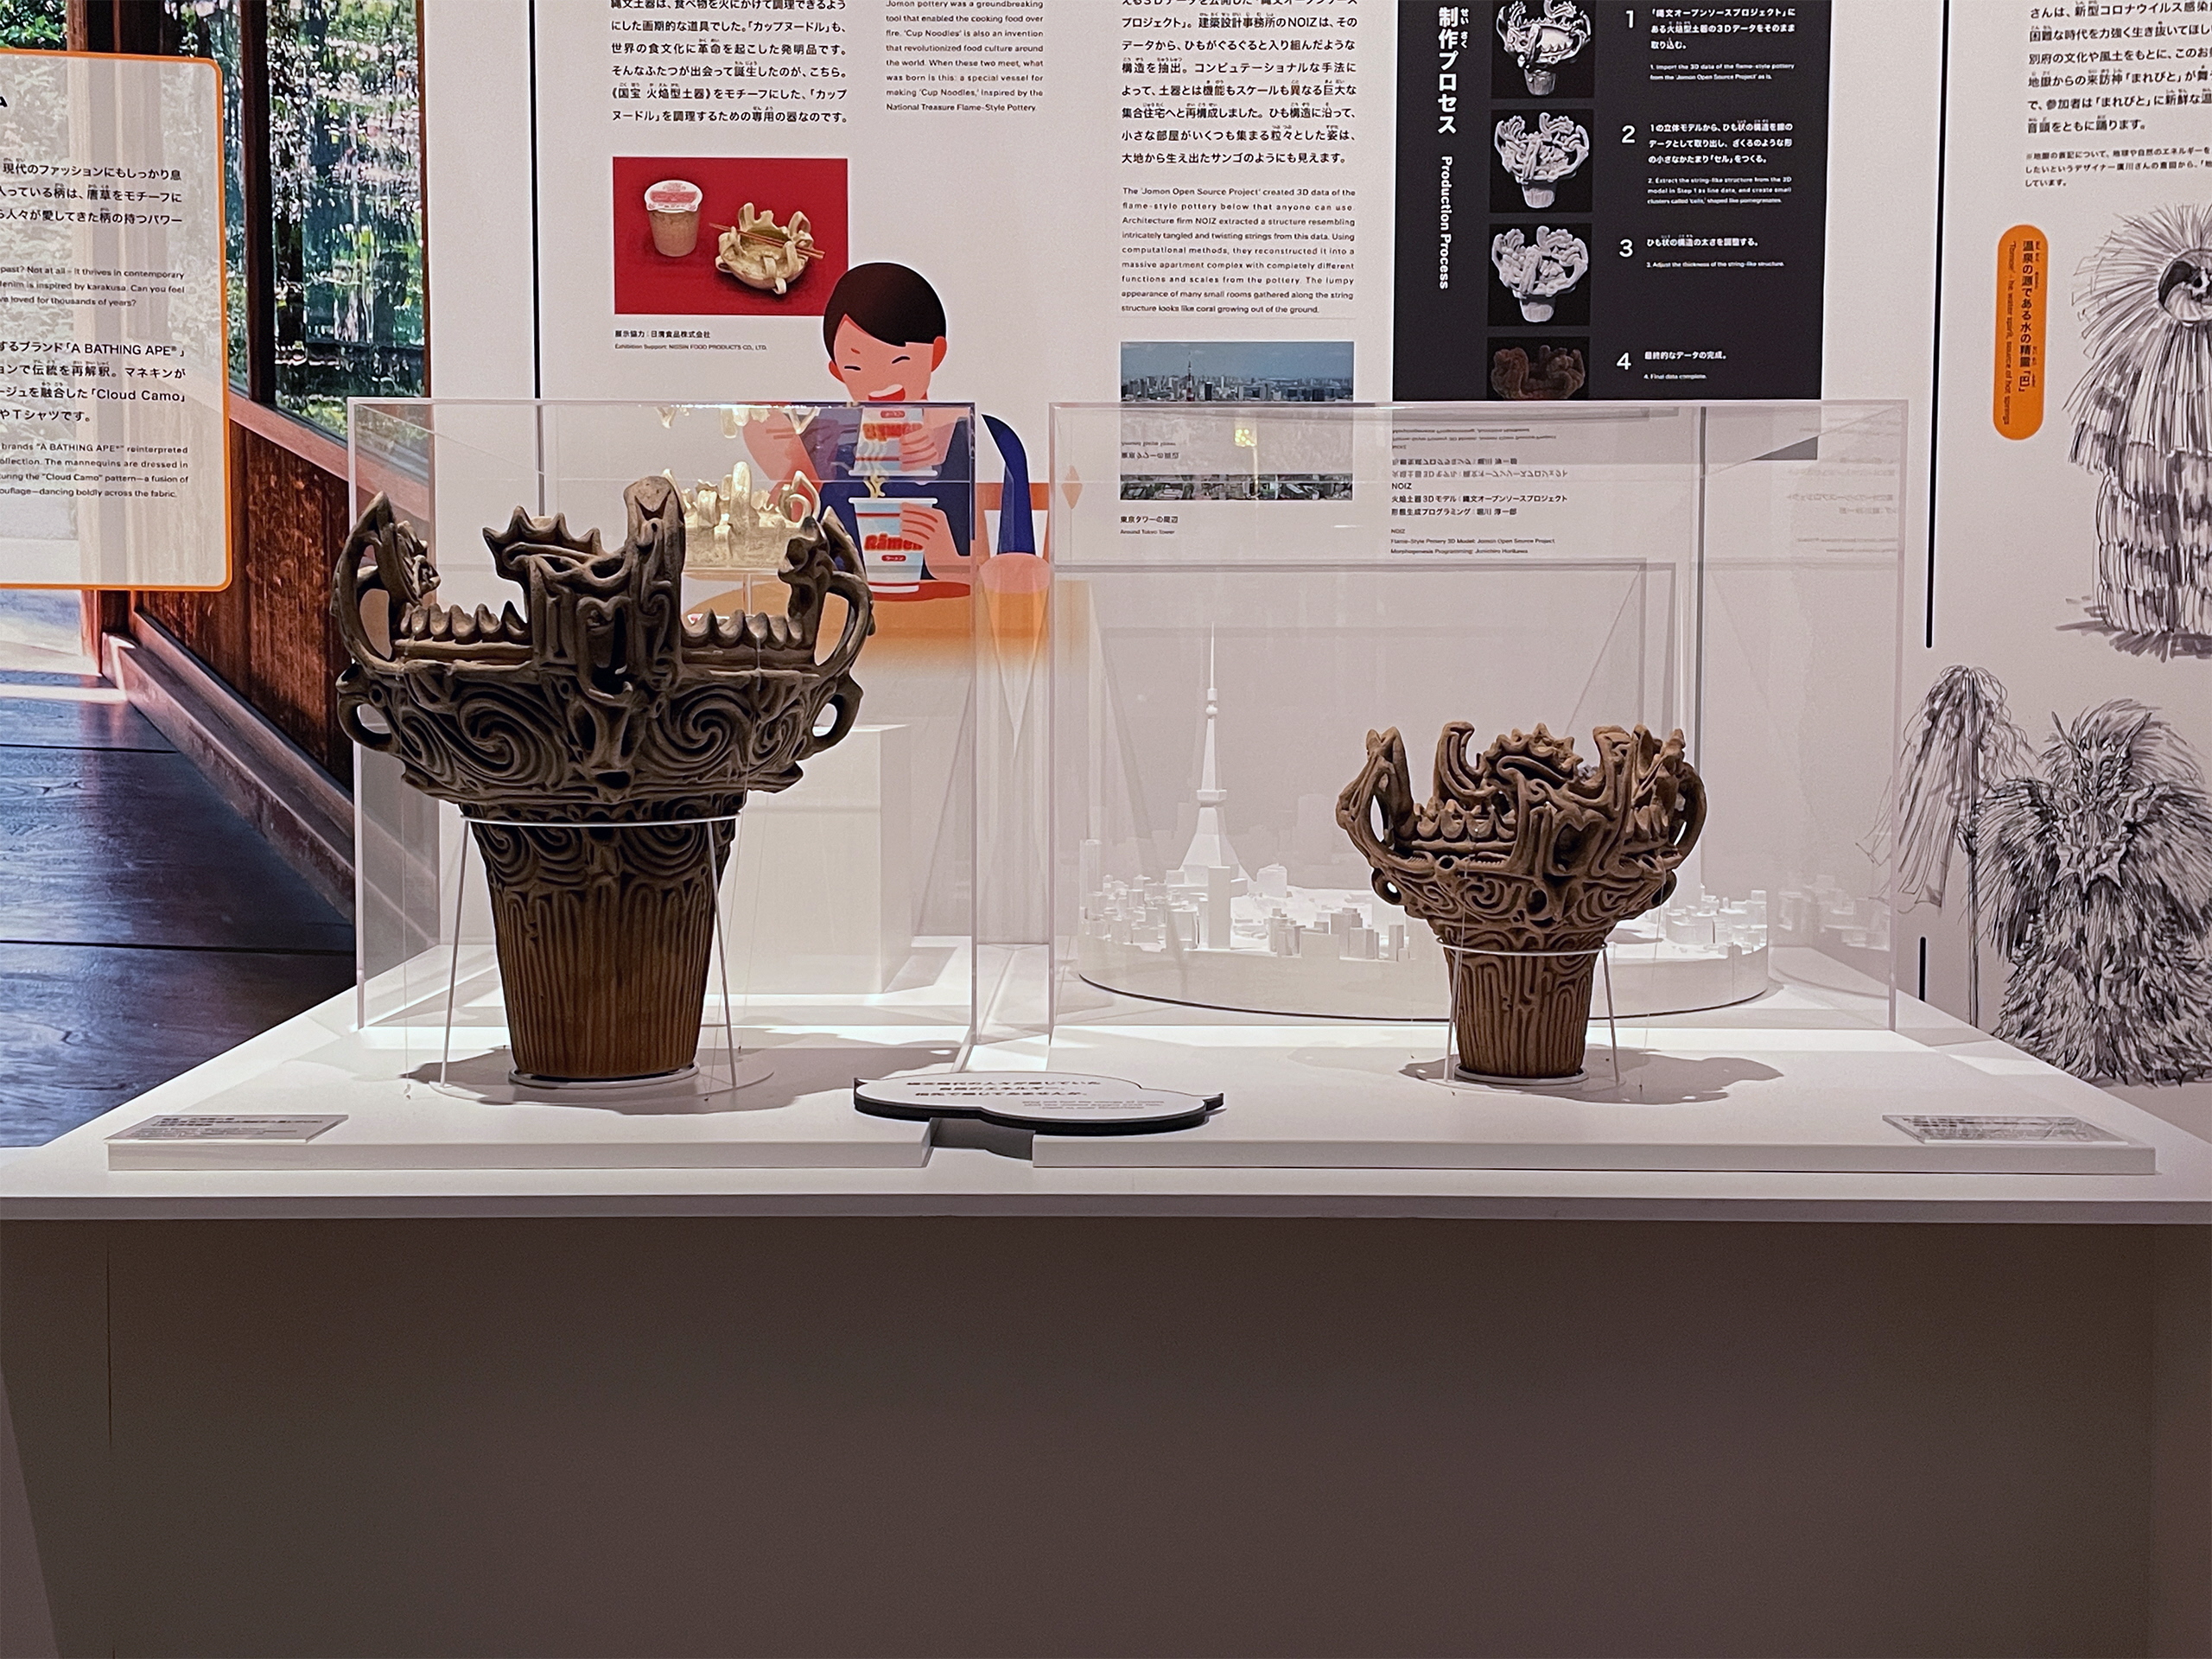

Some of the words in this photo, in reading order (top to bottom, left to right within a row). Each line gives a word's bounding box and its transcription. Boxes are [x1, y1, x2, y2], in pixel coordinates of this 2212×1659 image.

[2031, 1, 2212, 18] さんは、新型コロナウイルス感染
[1626, 10, 1633, 28] 1
[2030, 24, 2212, 42] 困難な時代を力強く生き抜いてほし
[611, 44, 846, 54] 世界の食文化に革命を起こした発明品です。
[1122, 40, 1356, 50] データから、ひもがぐるぐると入り組んだような
[2029, 48, 2212, 64] 別府の文化や風土をもとに、このお
[611, 66, 846, 78] そんなふたつが出会って誕生したのが、こちら。
[1438, 7, 1458, 134] 制作プロセス
[2029, 71, 2212, 87] 地獄からの来訪神「まれびと」が舞
[1122, 86, 1356, 96] よって、土器とは機能もスケールも異なる巨大な
[611, 111, 847, 123] ヌードル」を調理するための専用の器なのです。
[1122, 108, 1356, 118] 集合住宅へと再構成しました。ひも構造に沿って、
[1122, 131, 1356, 141] 小さな部屋がいくつも集まる粒々とした姿は、
[1622, 125, 1635, 143] 2
[1122, 154, 1345, 163] 大地から生え出たサンゴのようにも見えます。
[3, 163, 181, 181] 現代のファッションにもしっかり息
[1440, 156, 1452, 230] Production
[1619, 239, 1633, 257] 3
[1440, 233, 1452, 289] Process
[36, 282, 72, 290] inspired
[85, 343, 141, 355] BATHING
[1617, 353, 1631, 370] 4
